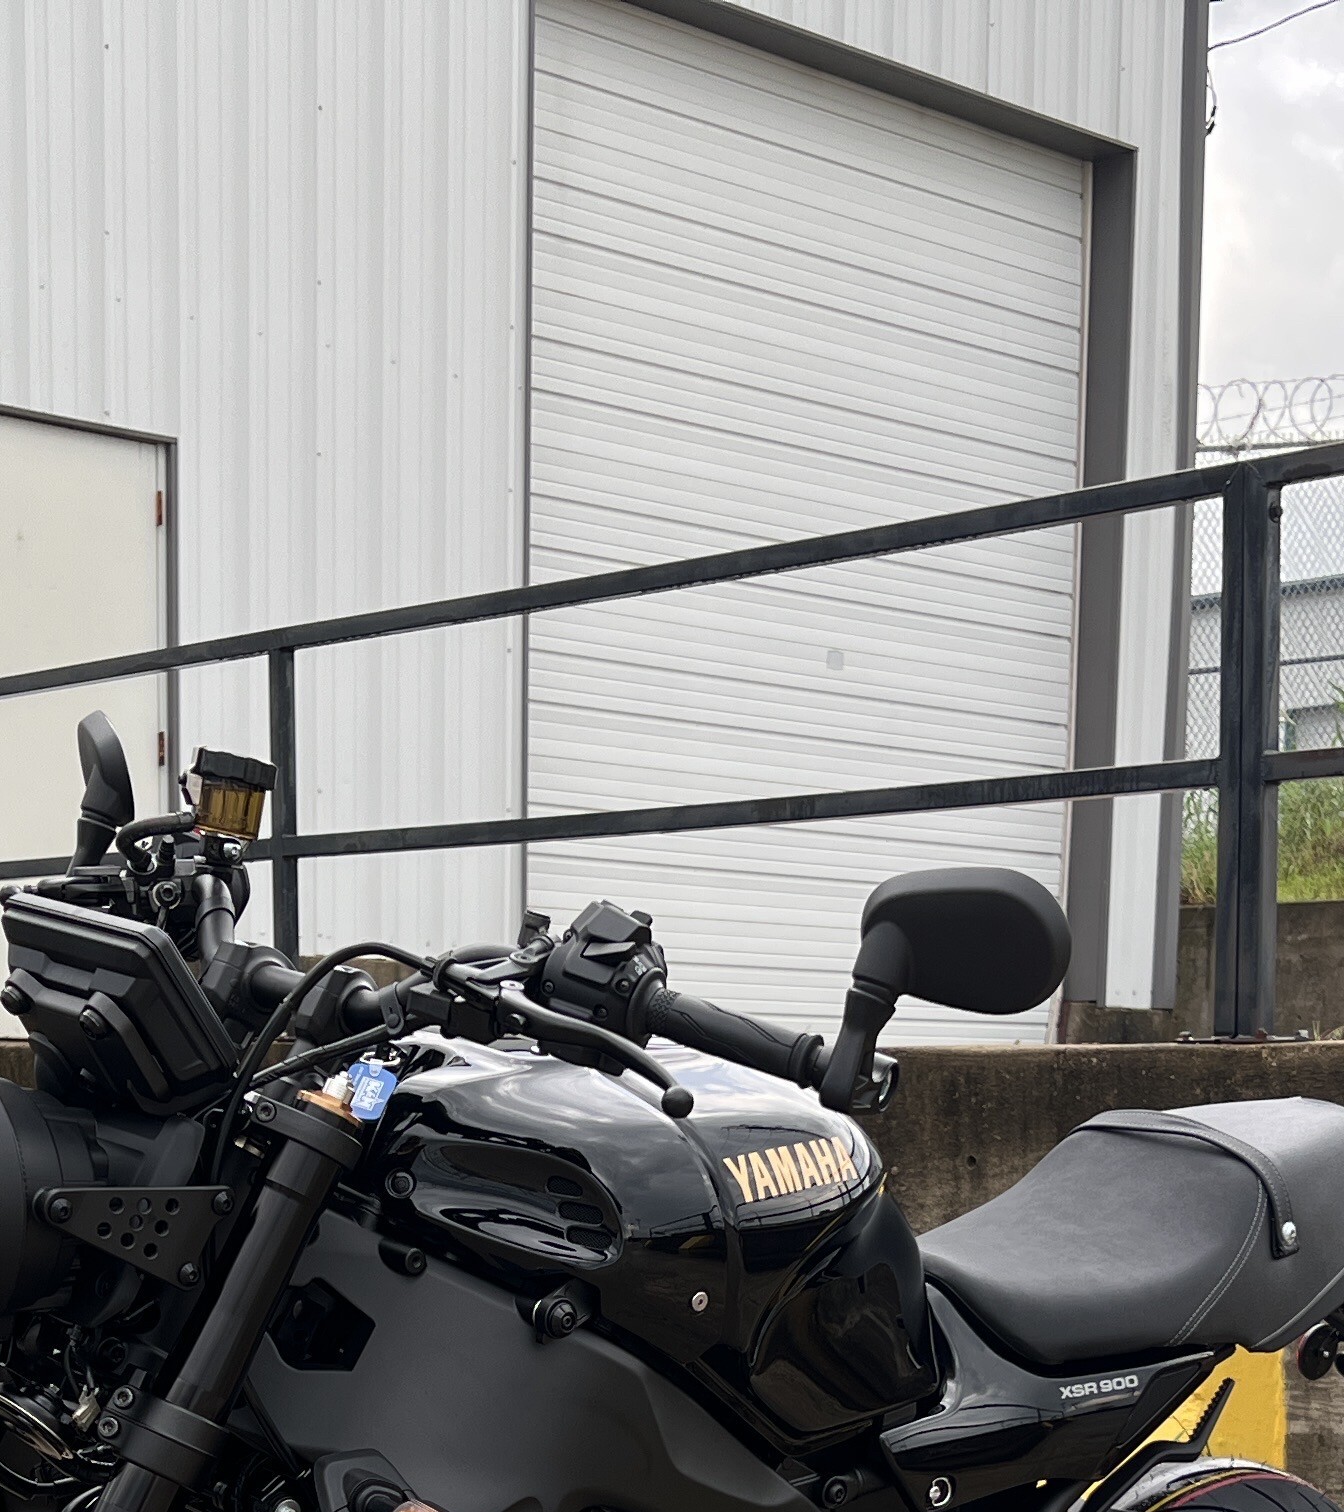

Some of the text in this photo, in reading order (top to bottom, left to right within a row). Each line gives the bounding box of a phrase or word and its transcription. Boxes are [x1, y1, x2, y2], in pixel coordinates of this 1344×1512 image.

[722, 1136, 858, 1203] YAMAHA
[1059, 1375, 1139, 1400] XSR 900
